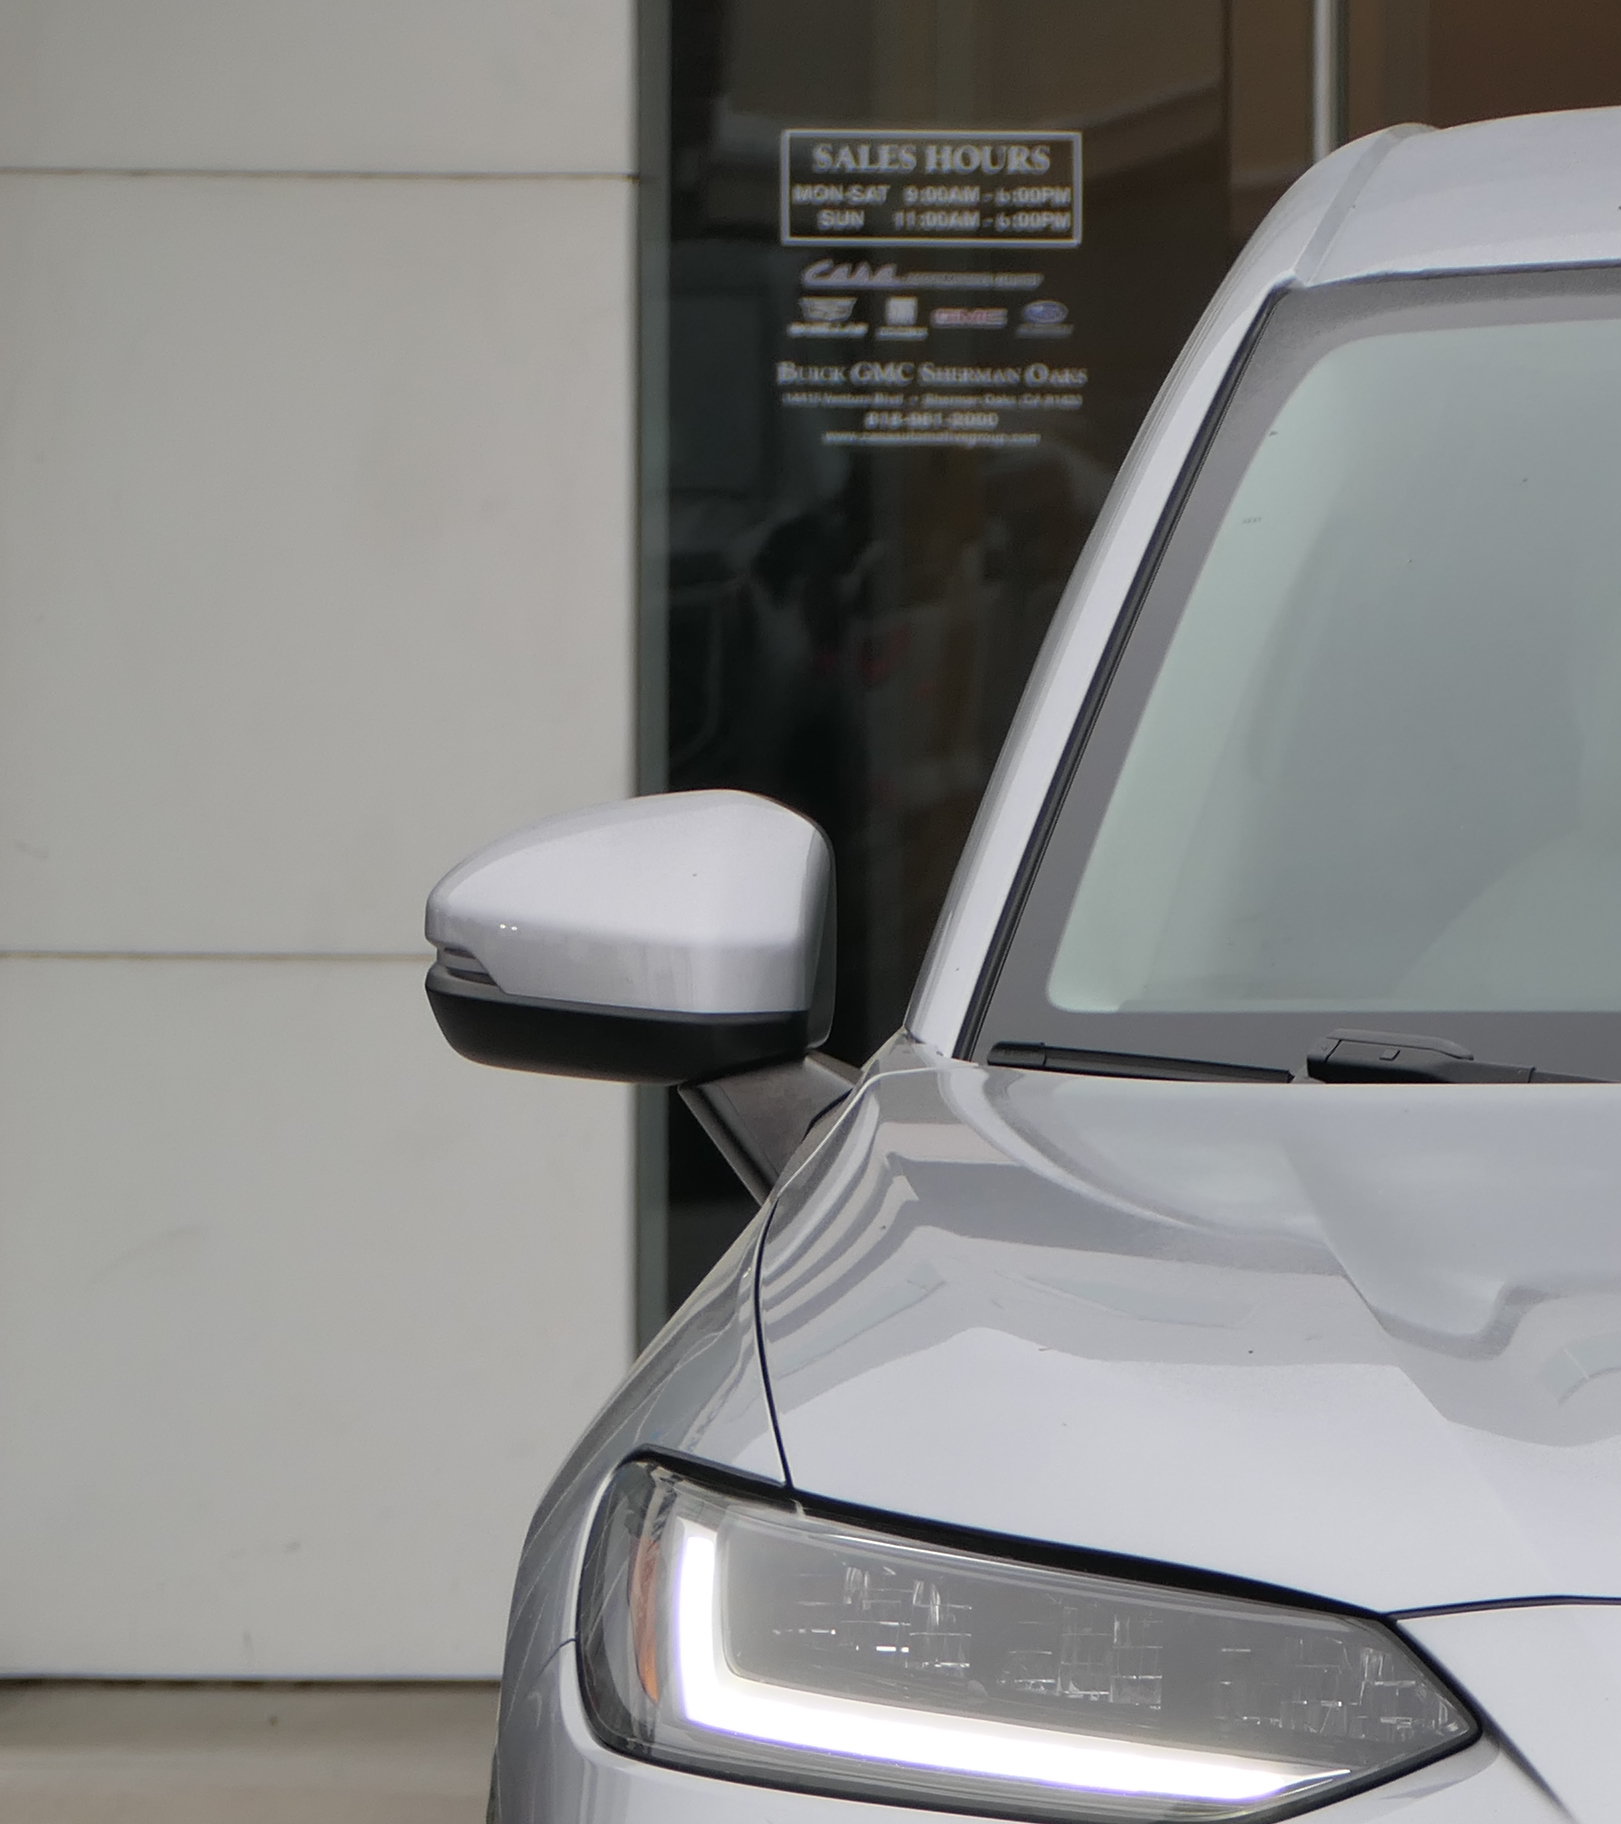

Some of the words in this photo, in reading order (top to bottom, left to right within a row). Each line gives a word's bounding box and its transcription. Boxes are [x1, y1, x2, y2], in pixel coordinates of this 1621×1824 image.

[813, 144, 916, 173] SALES
[924, 145, 1050, 174] HOURS
[792, 184, 890, 205] MON-SAT
[902, 185, 981, 206] 9:00AM
[995, 186, 1072, 207] 6:00PM
[817, 209, 864, 230] SUN
[892, 210, 981, 230] 11:00AM
[995, 211, 1072, 231] 6:00PM
[777, 361, 847, 386] BUICK
[850, 362, 915, 386] GMC
[917, 362, 1020, 387] SHERMAN
[1024, 362, 1088, 388] OAKS
